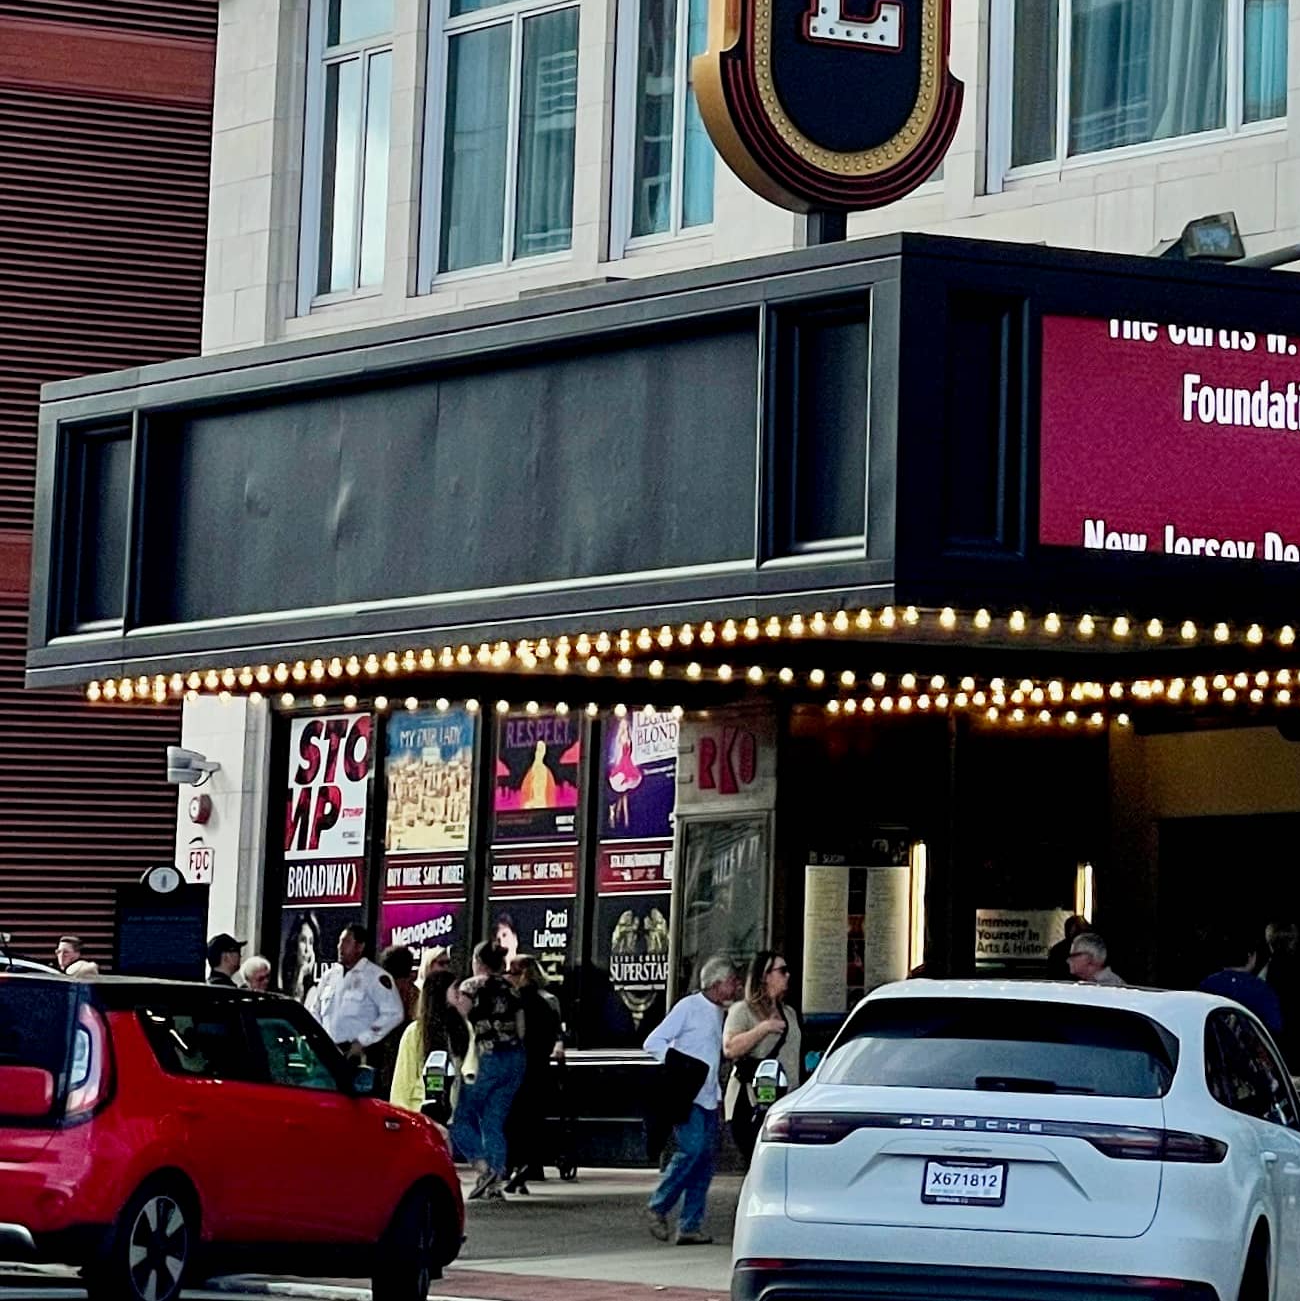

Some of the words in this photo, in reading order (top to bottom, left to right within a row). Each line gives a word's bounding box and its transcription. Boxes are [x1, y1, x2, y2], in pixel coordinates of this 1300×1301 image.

[400, 730, 415, 748] MY
[295, 716, 371, 785] STO
[698, 725, 756, 795] RKO
[189, 851, 209, 871] FDC
[288, 864, 350, 897] BROADWAY
[387, 868, 401, 887] BUY
[402, 867, 421, 886] MORE
[423, 866, 441, 886] SAVE
[546, 909, 567, 928] Patti
[977, 917, 1029, 928] Immerse
[391, 914, 453, 947] Menopause
[534, 930, 566, 948] LuPone
[977, 929, 1026, 941] Yourself
[1028, 930, 1040, 940] In
[977, 942, 1000, 953] Arts
[900, 1117, 1042, 1132] PORSCHE
[932, 1172, 998, 1188] X671812
